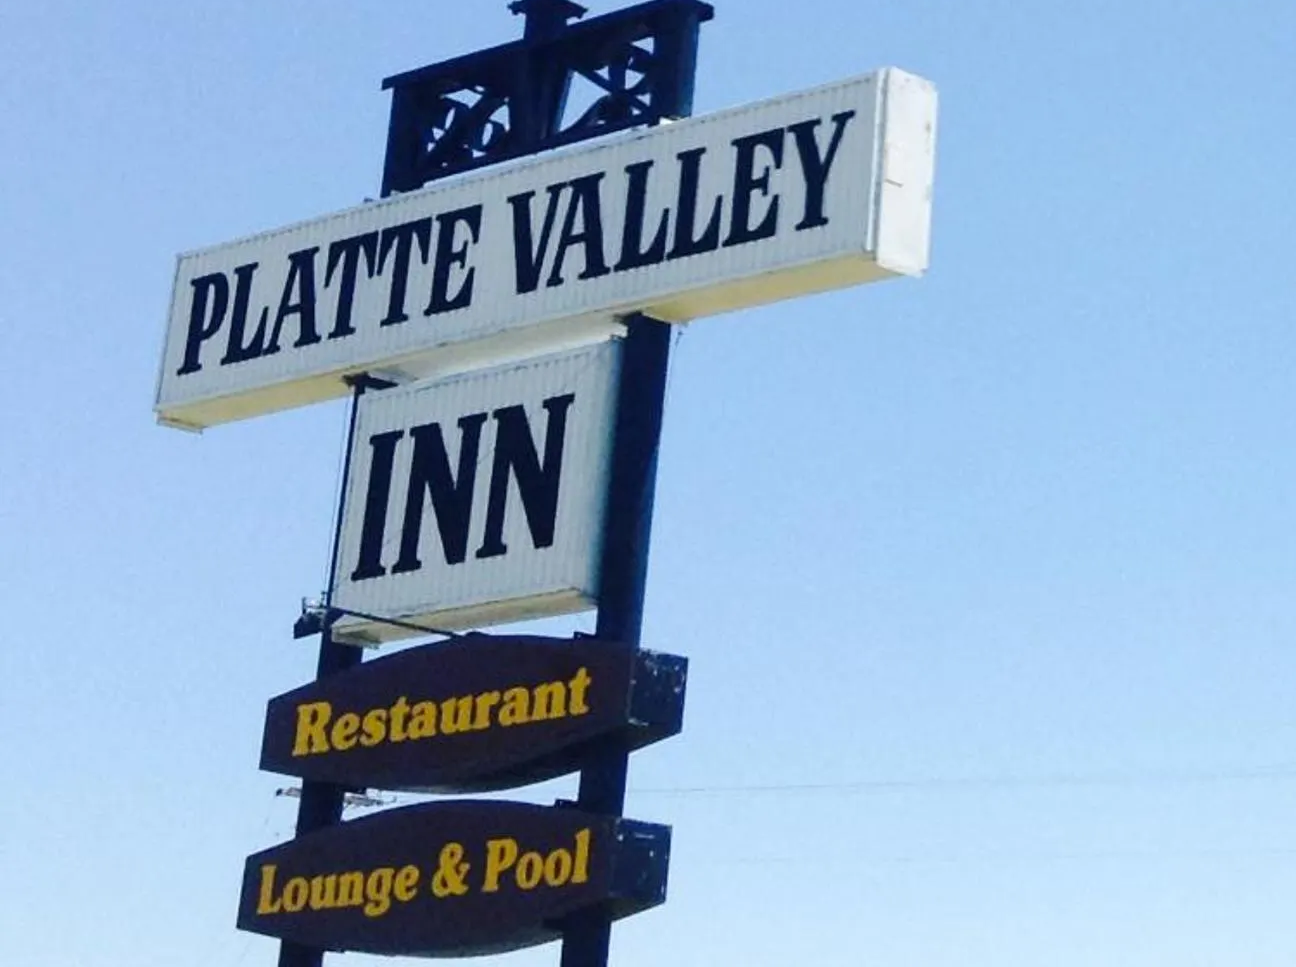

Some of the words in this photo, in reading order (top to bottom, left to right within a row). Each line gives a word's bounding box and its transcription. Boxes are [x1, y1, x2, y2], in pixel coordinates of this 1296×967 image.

[176, 203, 483, 376] PLATTE
[506, 110, 856, 295] VALLEY
[350, 392, 576, 582] INN
[292, 666, 592, 757] Restaurant
[256, 863, 419, 918] Lounge
[432, 842, 470, 898] &
[482, 827, 591, 893] Pool
